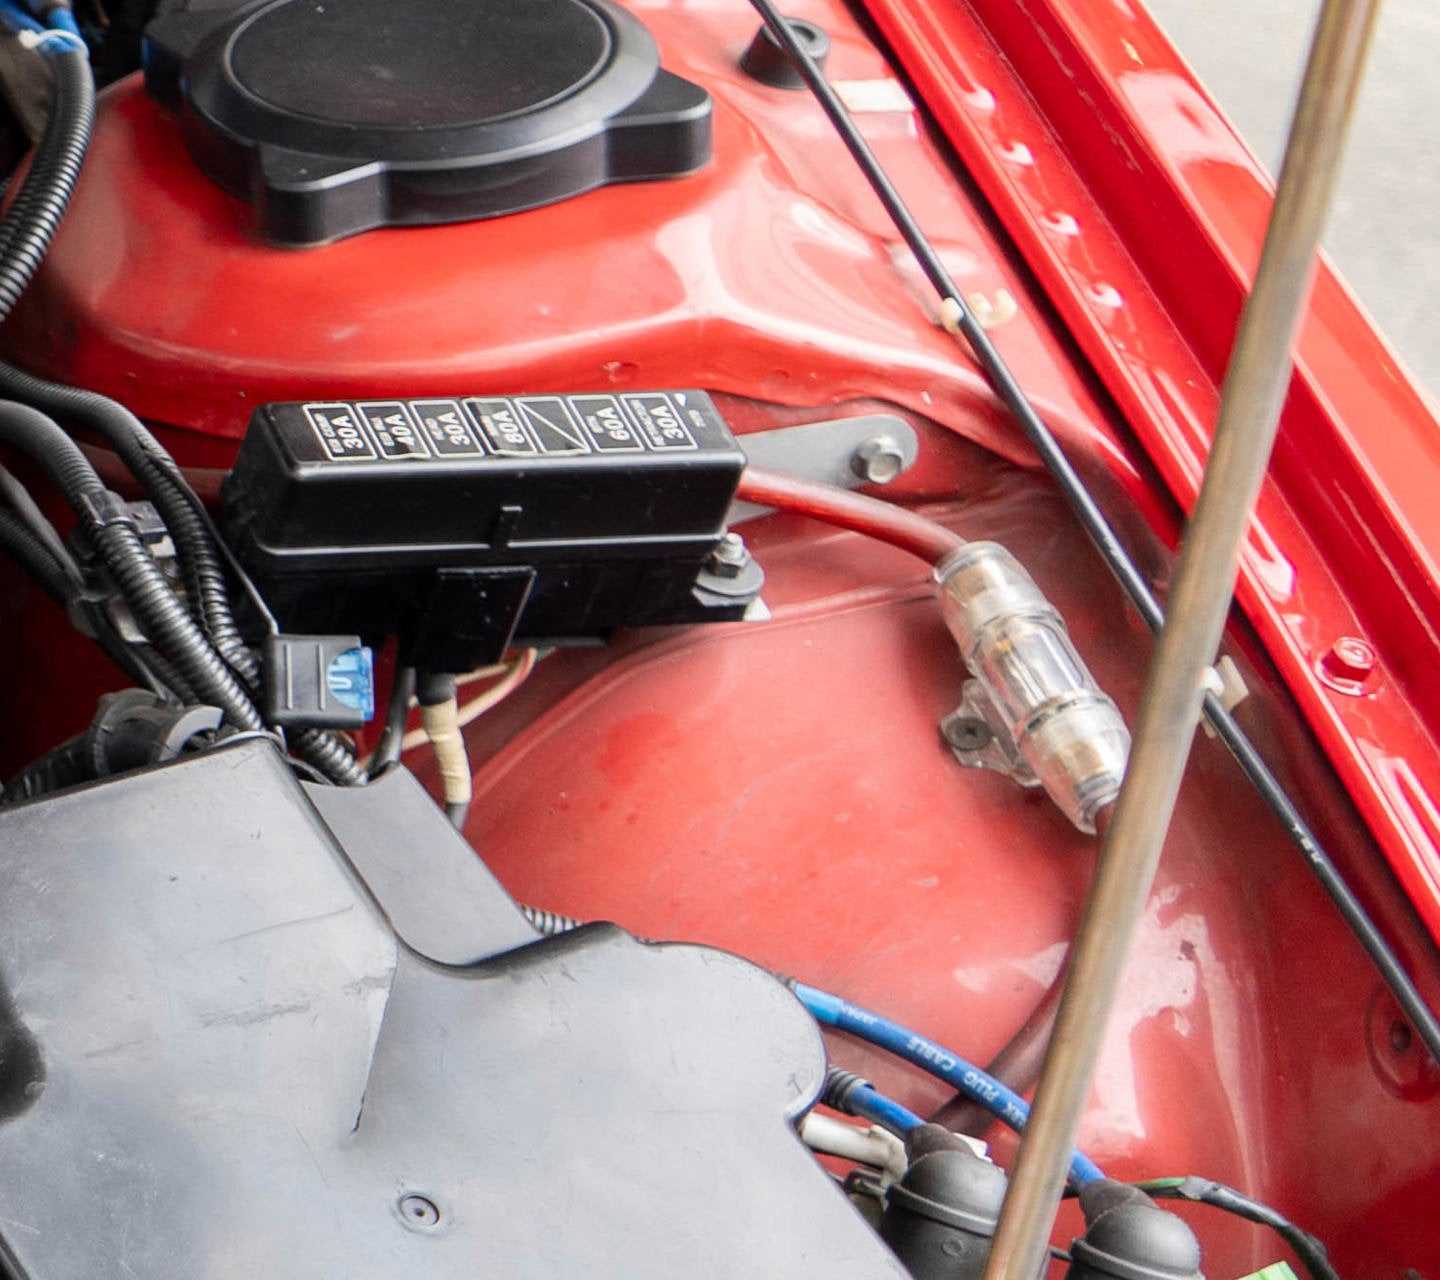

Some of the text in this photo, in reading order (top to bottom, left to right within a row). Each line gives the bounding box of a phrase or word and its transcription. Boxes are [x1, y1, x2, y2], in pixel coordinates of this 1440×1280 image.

[332, 414, 364, 449] 30A
[438, 411, 470, 446] 30A
[597, 407, 630, 441] 60A
[650, 405, 684, 439] 30A
[906, 1036, 956, 1071] CABLE
[963, 1071, 1000, 1103] PLUG
